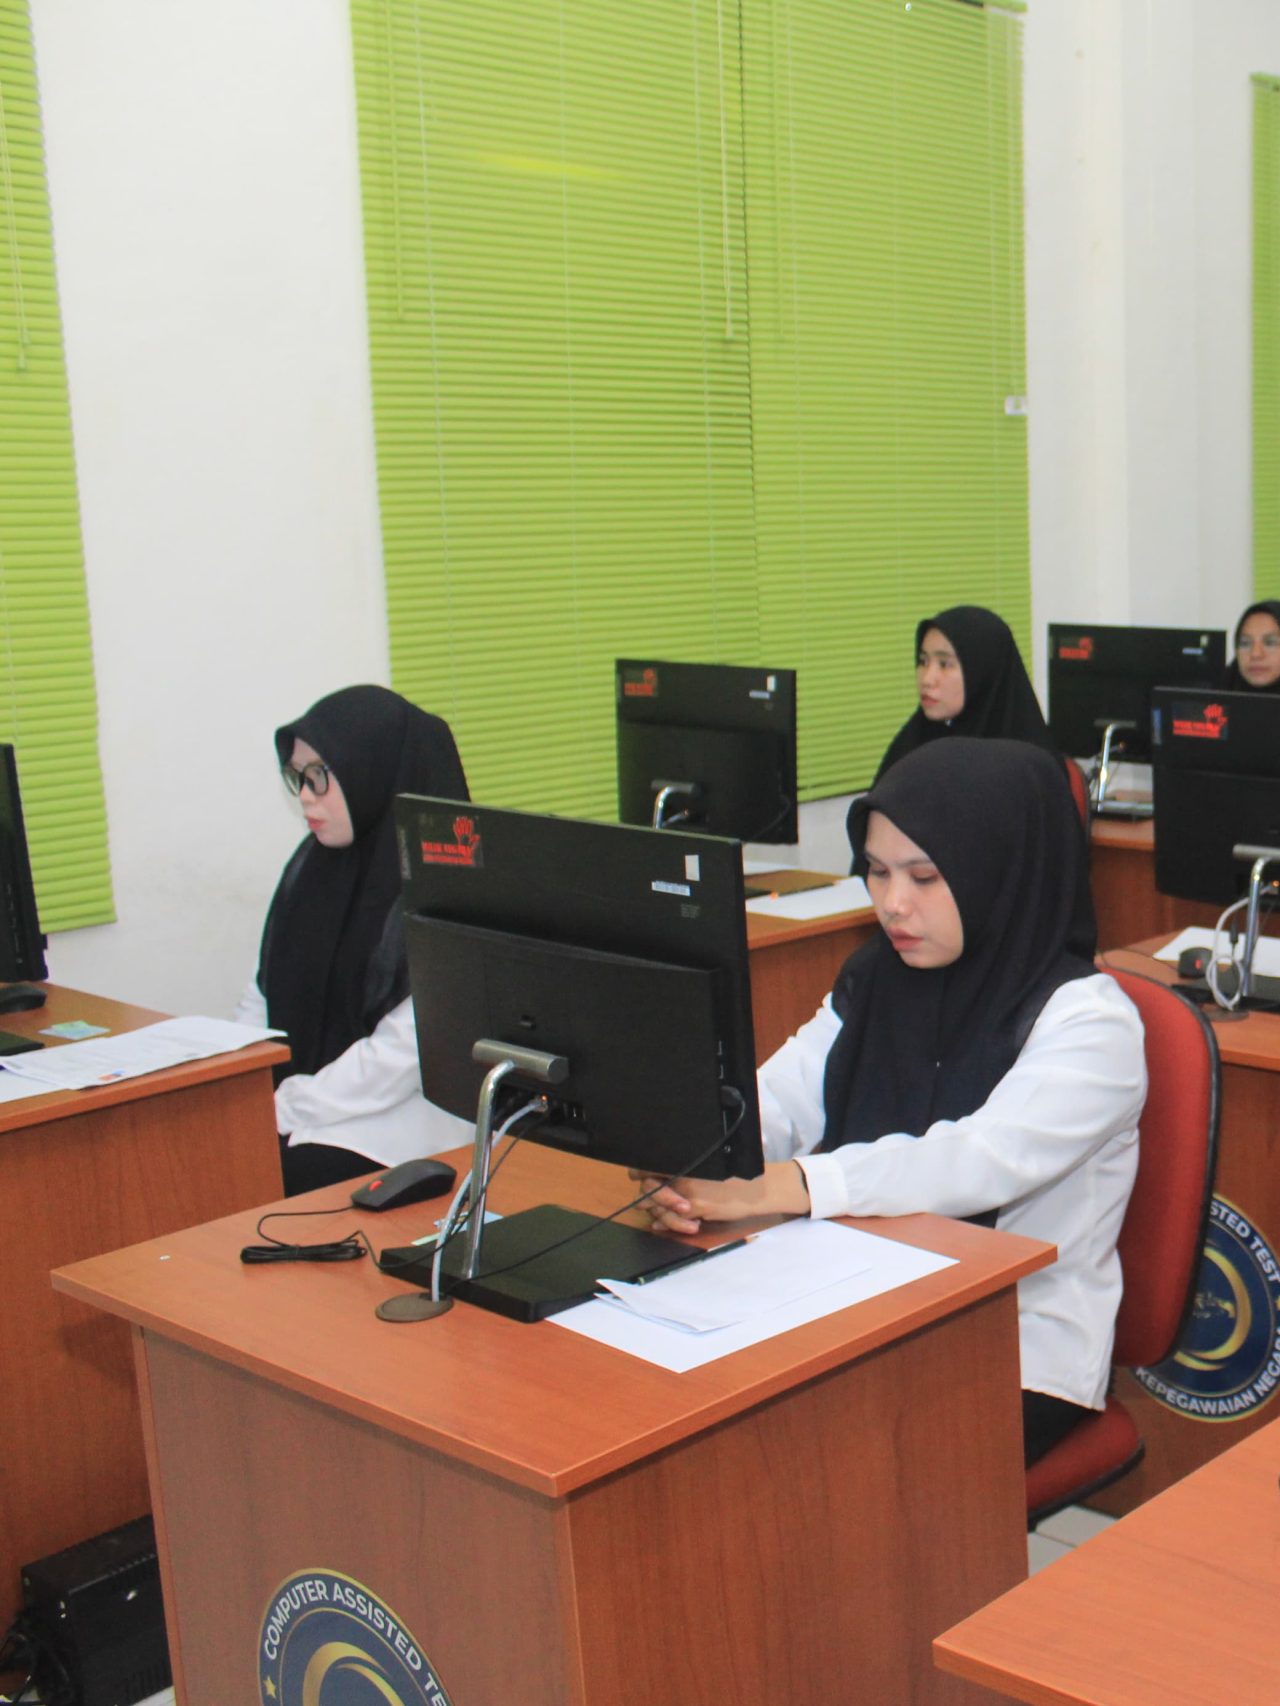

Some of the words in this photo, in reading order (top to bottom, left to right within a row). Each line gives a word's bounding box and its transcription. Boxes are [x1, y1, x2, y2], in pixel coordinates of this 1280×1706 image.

[1210, 1200, 1251, 1238] STED
[1135, 1366, 1257, 1415] KEPEGAWAIAN
[263, 1579, 329, 1662] COMPUTER
[332, 1581, 423, 1671] ASSISTED
[424, 1671, 448, 1706] TE
